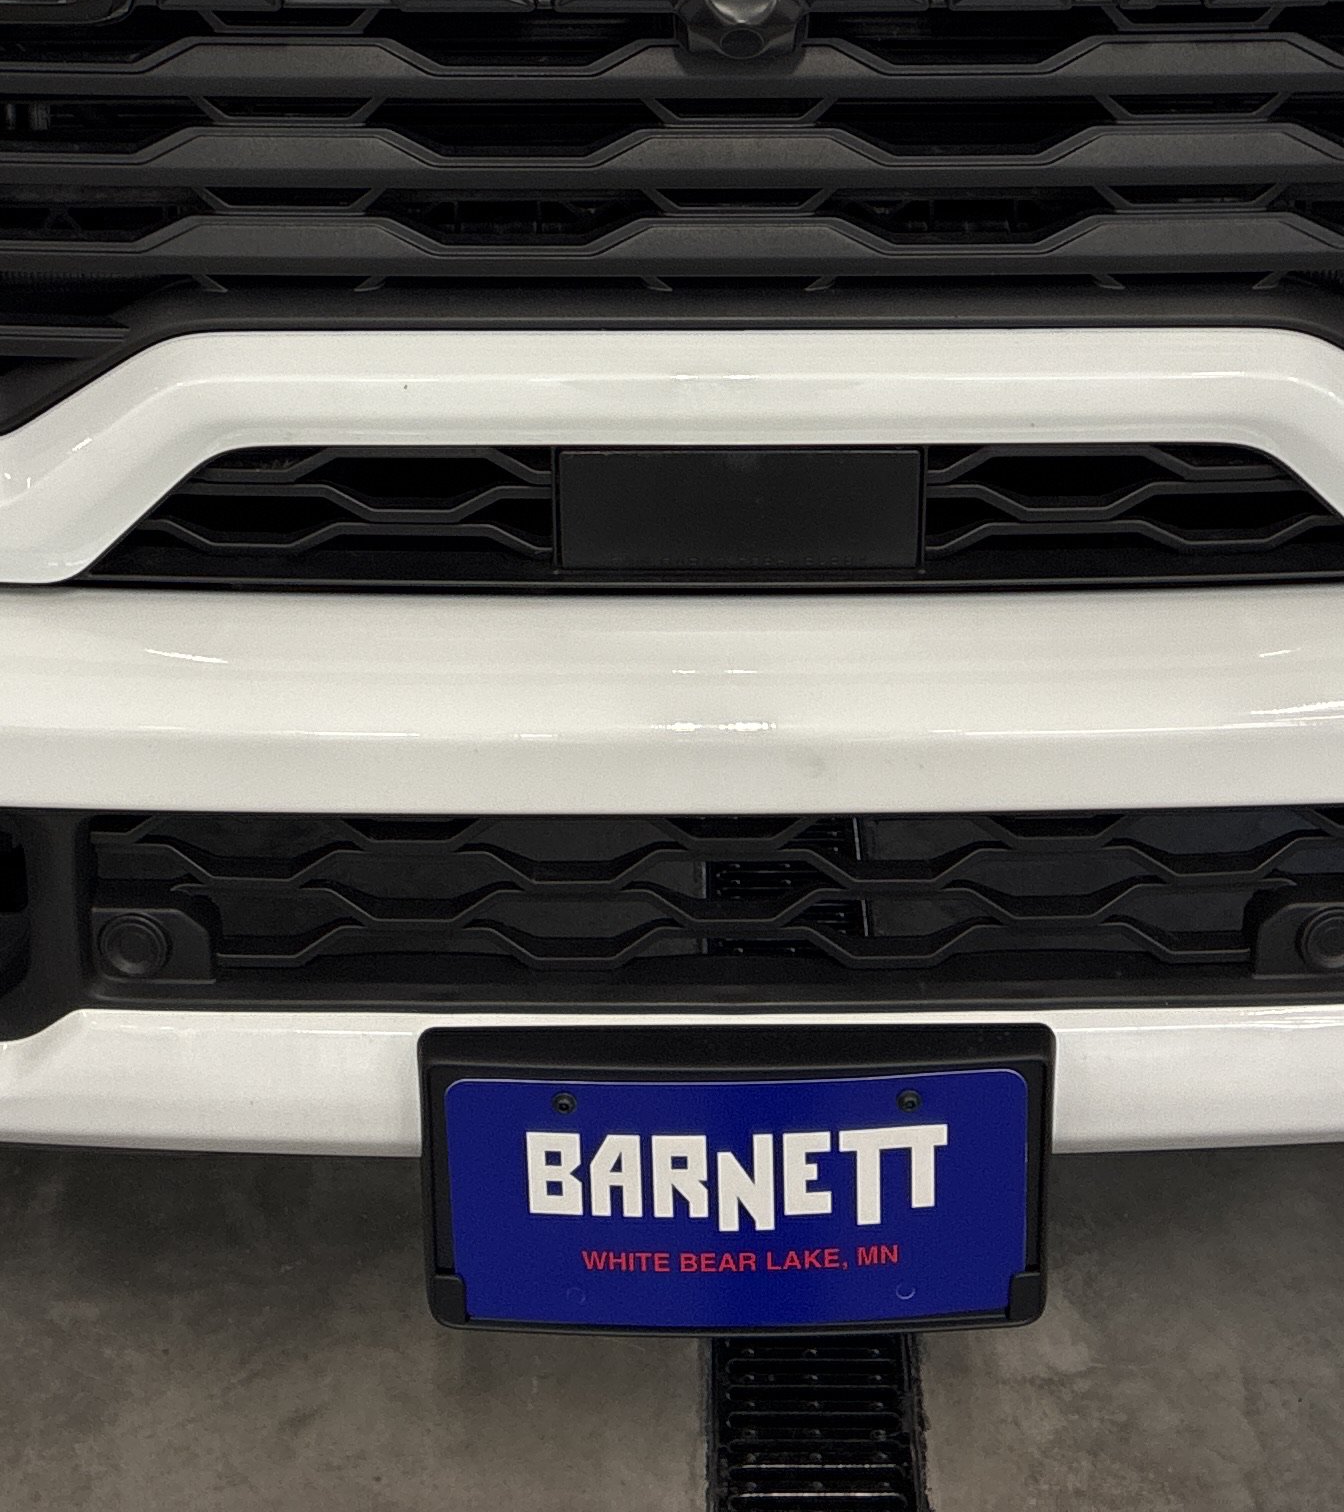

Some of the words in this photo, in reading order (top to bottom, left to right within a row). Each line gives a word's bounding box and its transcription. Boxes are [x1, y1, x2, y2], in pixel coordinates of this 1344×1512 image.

[525, 1123, 949, 1232] BARNETT
[582, 1249, 670, 1273] WHITE
[679, 1251, 757, 1273] BEAR
[766, 1247, 849, 1272] LAKE,
[857, 1244, 900, 1267] MN
